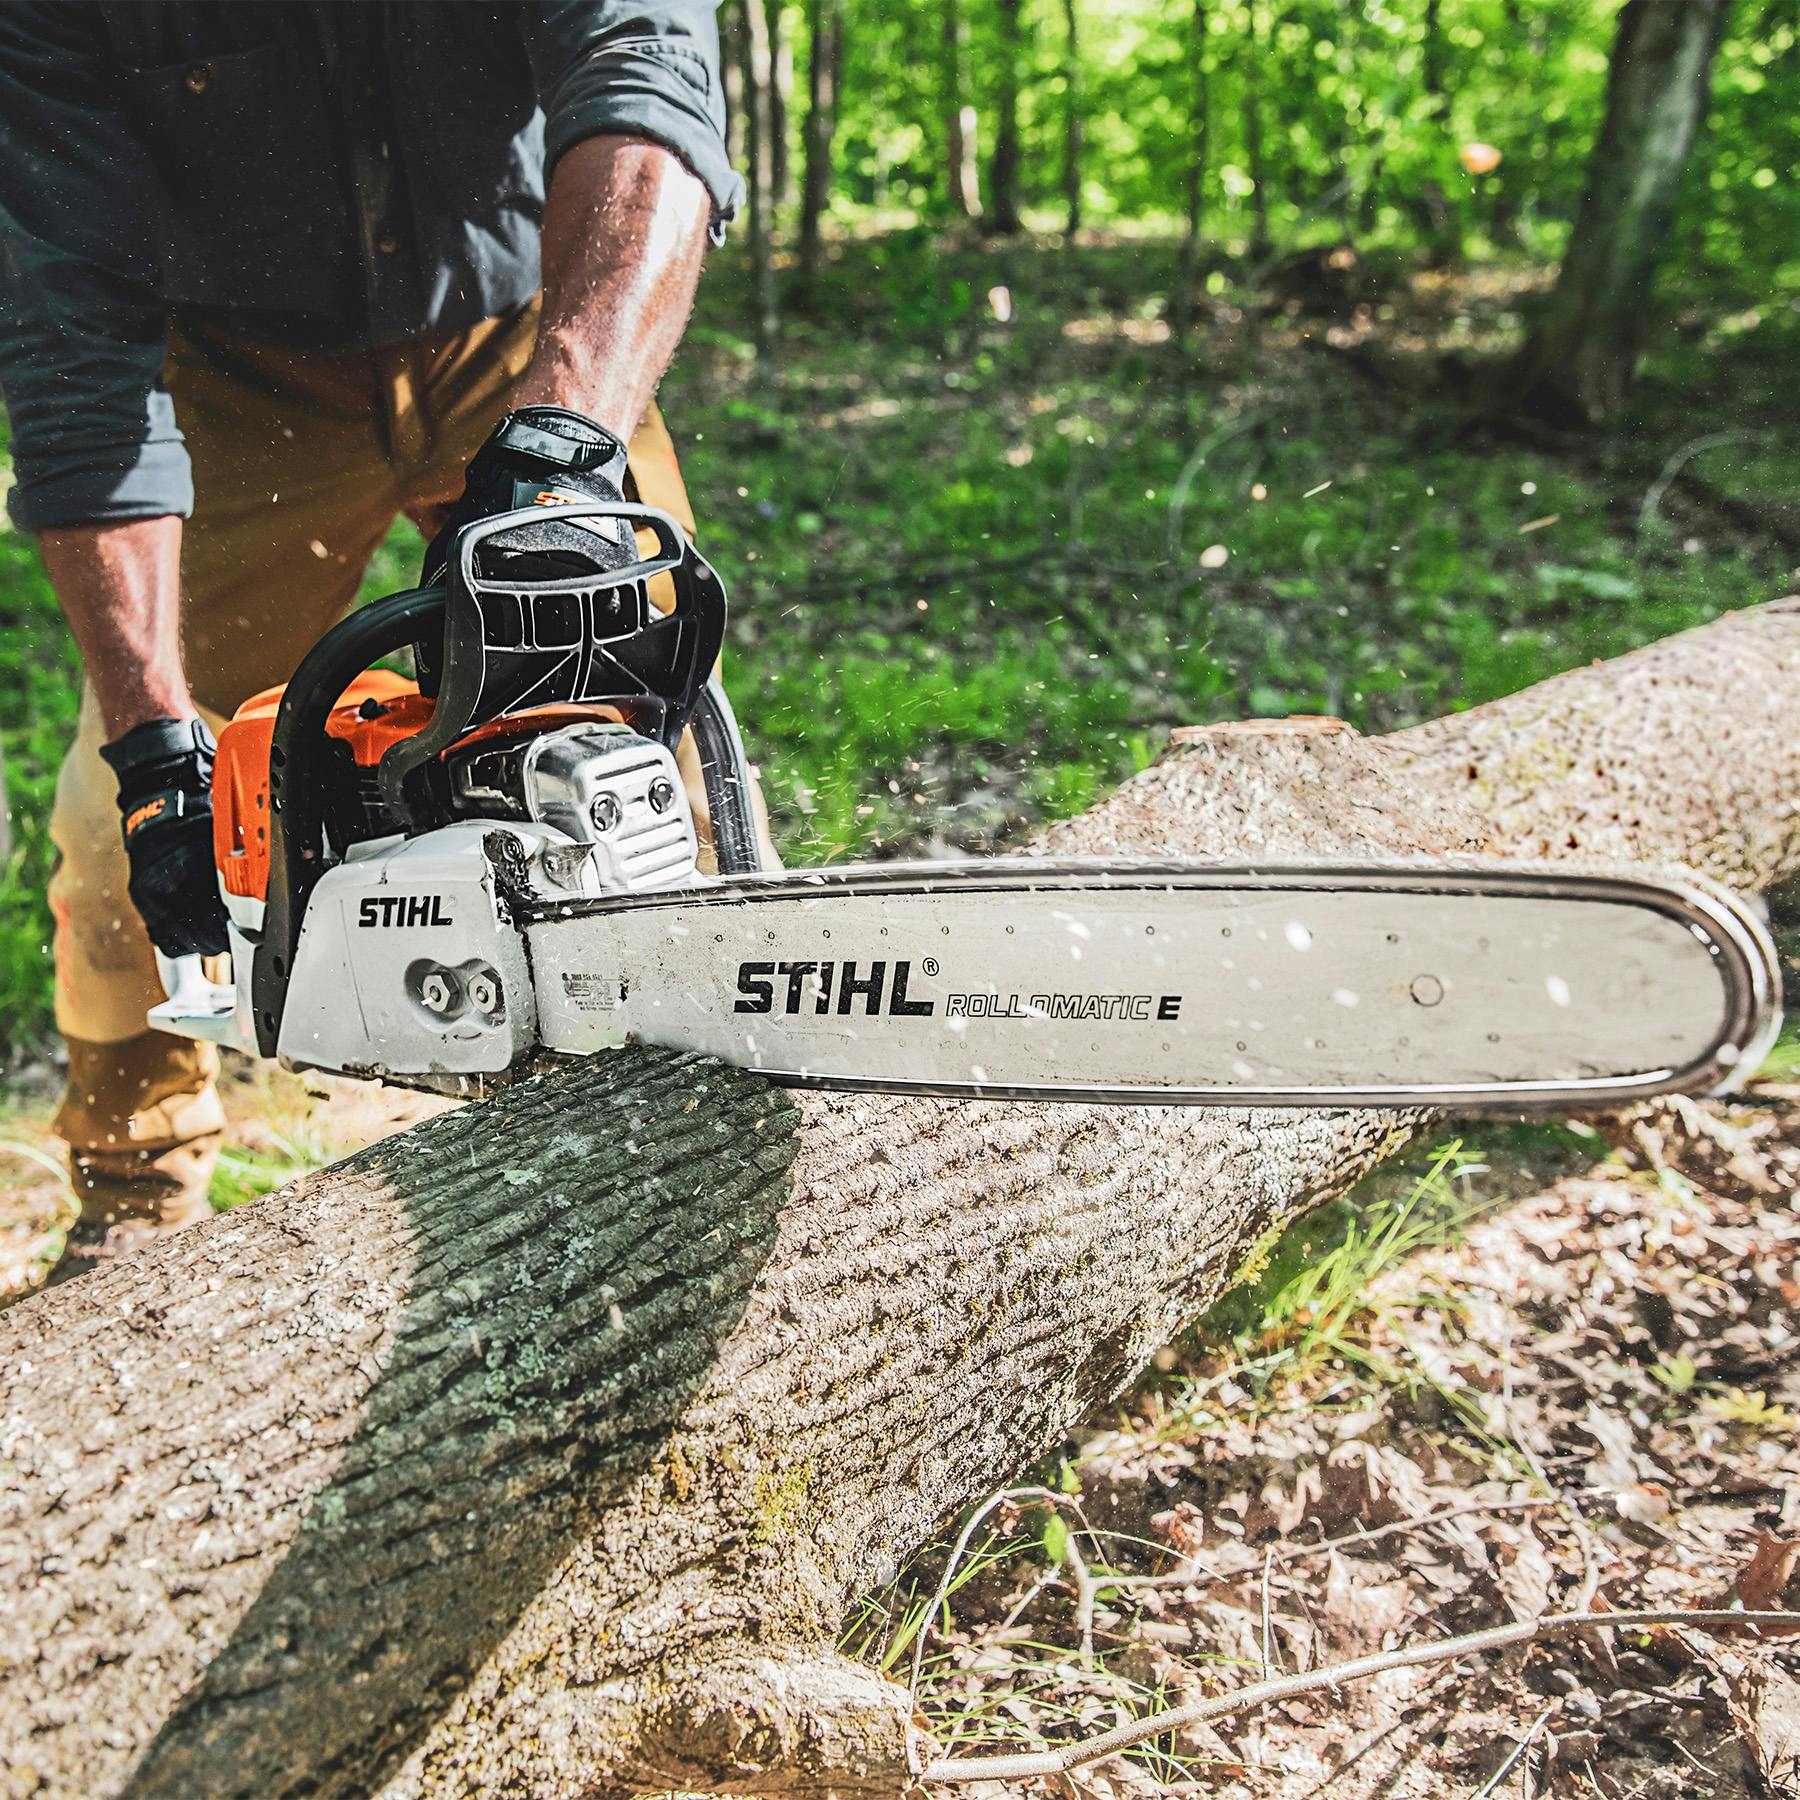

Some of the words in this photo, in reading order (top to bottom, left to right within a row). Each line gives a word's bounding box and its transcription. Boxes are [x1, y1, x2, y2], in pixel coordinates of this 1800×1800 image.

[358, 895, 453, 928] STIHL
[733, 960, 935, 1016] STIHL
[945, 993, 1153, 1020] ROLLOMATIC
[1156, 995, 1183, 1020] E
